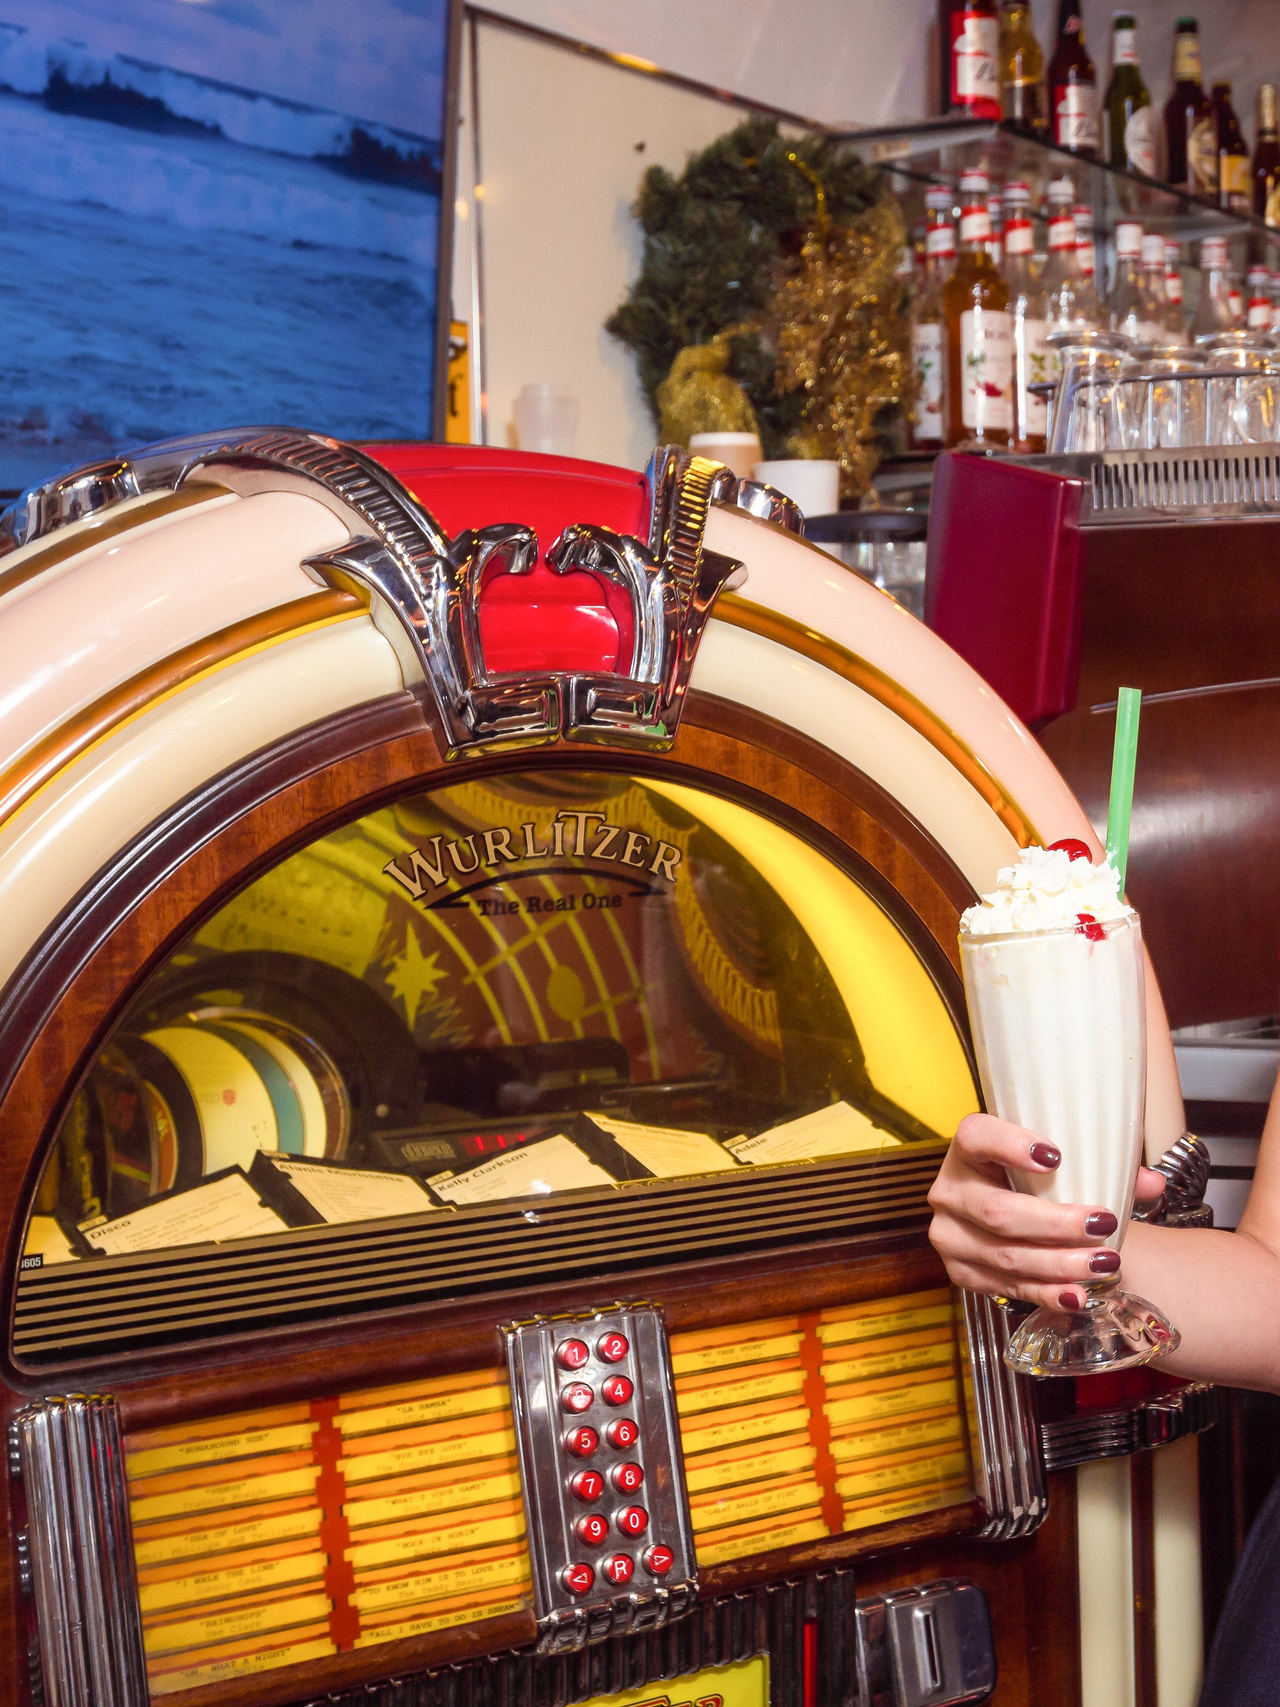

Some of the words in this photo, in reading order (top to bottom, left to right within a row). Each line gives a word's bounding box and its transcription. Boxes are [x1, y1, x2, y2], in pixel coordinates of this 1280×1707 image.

[382, 810, 683, 900] WURLITZER
[477, 900, 519, 916] The
[525, 894, 576, 912] Real
[581, 892, 622, 909] One
[735, 1137, 768, 1154] Adele
[279, 1164, 323, 1174] Alanis
[327, 1169, 404, 1182] Morissette
[438, 1176, 470, 1192] Kelly
[473, 1152, 528, 1178] Clarkson
[90, 1220, 131, 1239] Disco
[572, 1347, 579, 1361] 1
[611, 1340, 622, 1355] 2
[614, 1383, 624, 1398] 4
[581, 1433, 591, 1448] 5
[620, 1426, 630, 1441] 6
[585, 1478, 595, 1494] 7
[625, 1470, 635, 1486] 8
[591, 1521, 601, 1536] 9
[629, 1513, 640, 1528] 0
[614, 1560, 627, 1579] R
